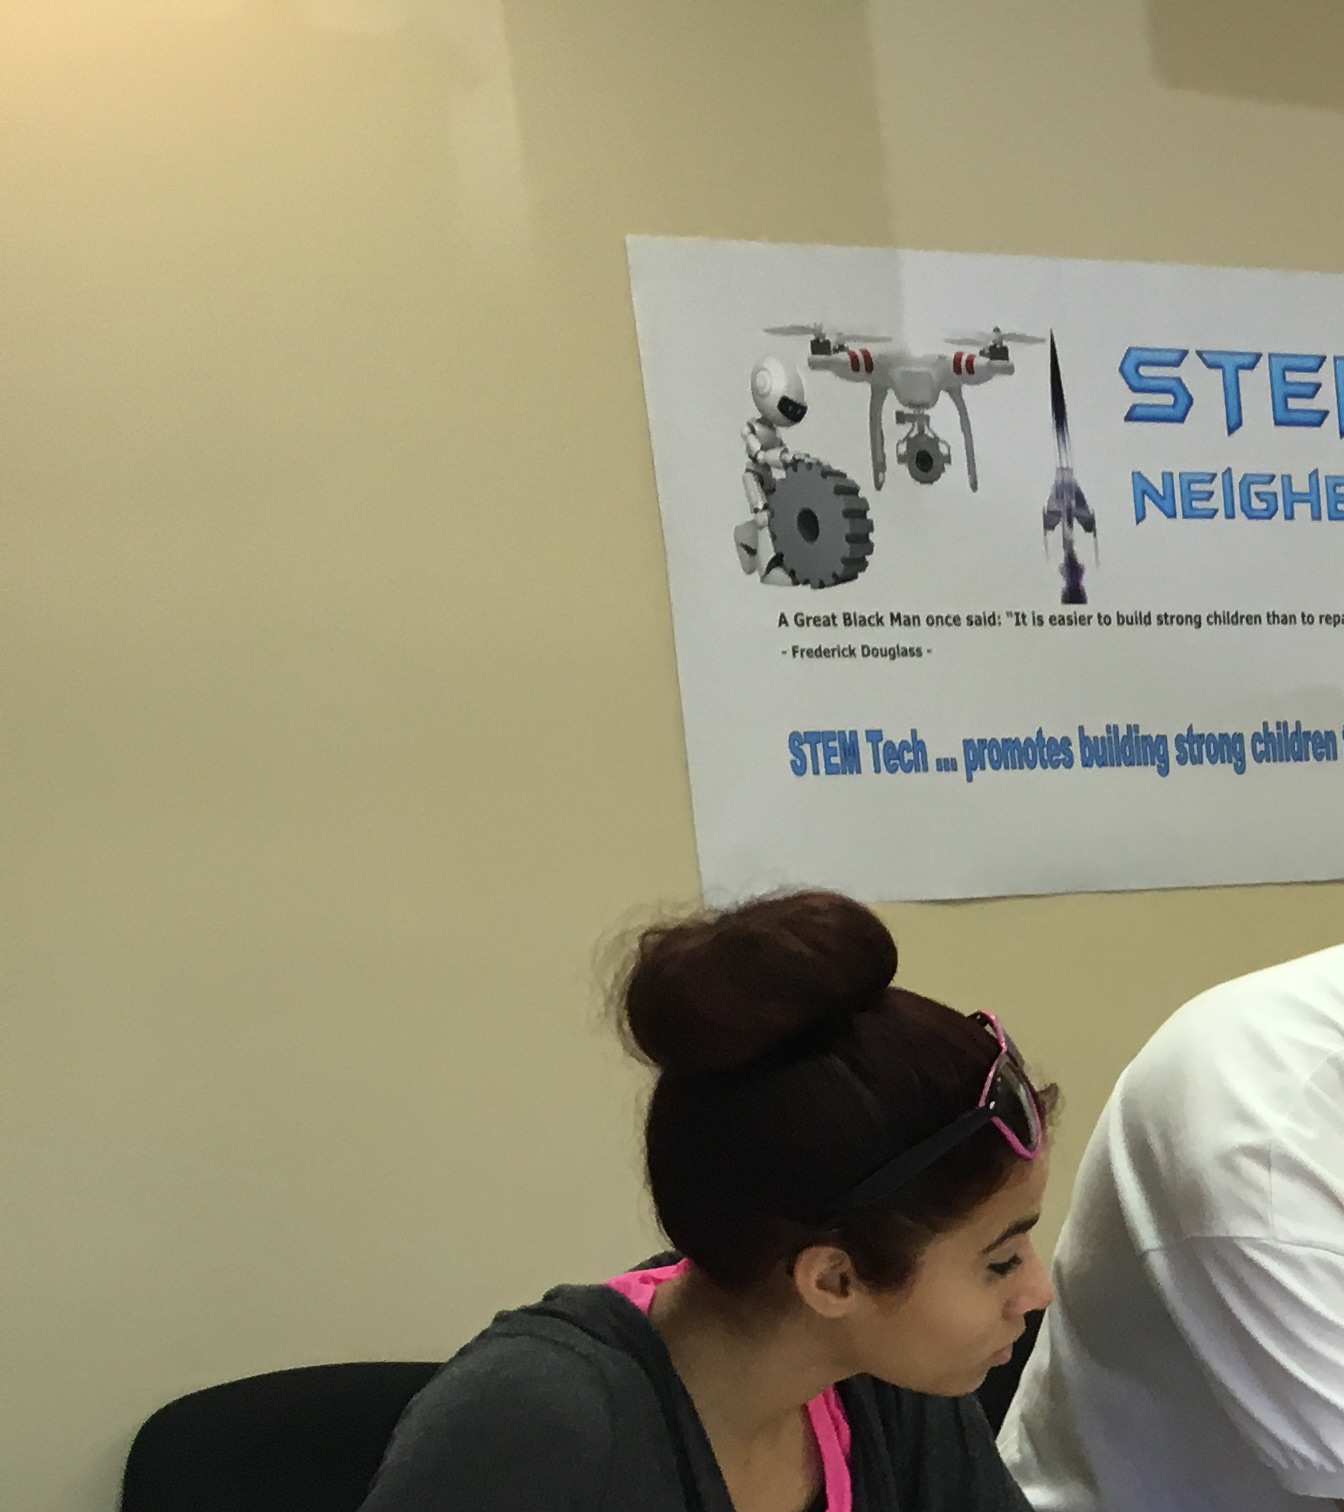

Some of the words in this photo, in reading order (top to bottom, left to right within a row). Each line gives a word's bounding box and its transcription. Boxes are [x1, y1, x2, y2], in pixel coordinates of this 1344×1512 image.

[778, 612, 789, 627] A
[793, 612, 838, 628] Great
[842, 611, 885, 627] Black
[889, 612, 921, 627] Man
[925, 614, 962, 627] once
[966, 611, 1002, 628] said:
[1031, 611, 1044, 627] is
[1048, 611, 1094, 627] easier
[1097, 612, 1112, 626] to
[1116, 611, 1151, 627] build
[1156, 613, 1202, 629] strong
[1206, 611, 1262, 626] children
[1266, 611, 1297, 626] than
[1300, 612, 1315, 626] to
[791, 644, 857, 659] Frederick
[861, 644, 923, 660] Douglass
[788, 729, 861, 777] STEM
[865, 728, 928, 774] Tech
[962, 727, 1074, 783] promotes
[1078, 723, 1170, 778] building
[1174, 723, 1247, 775] strong
[1251, 719, 1338, 763] children
